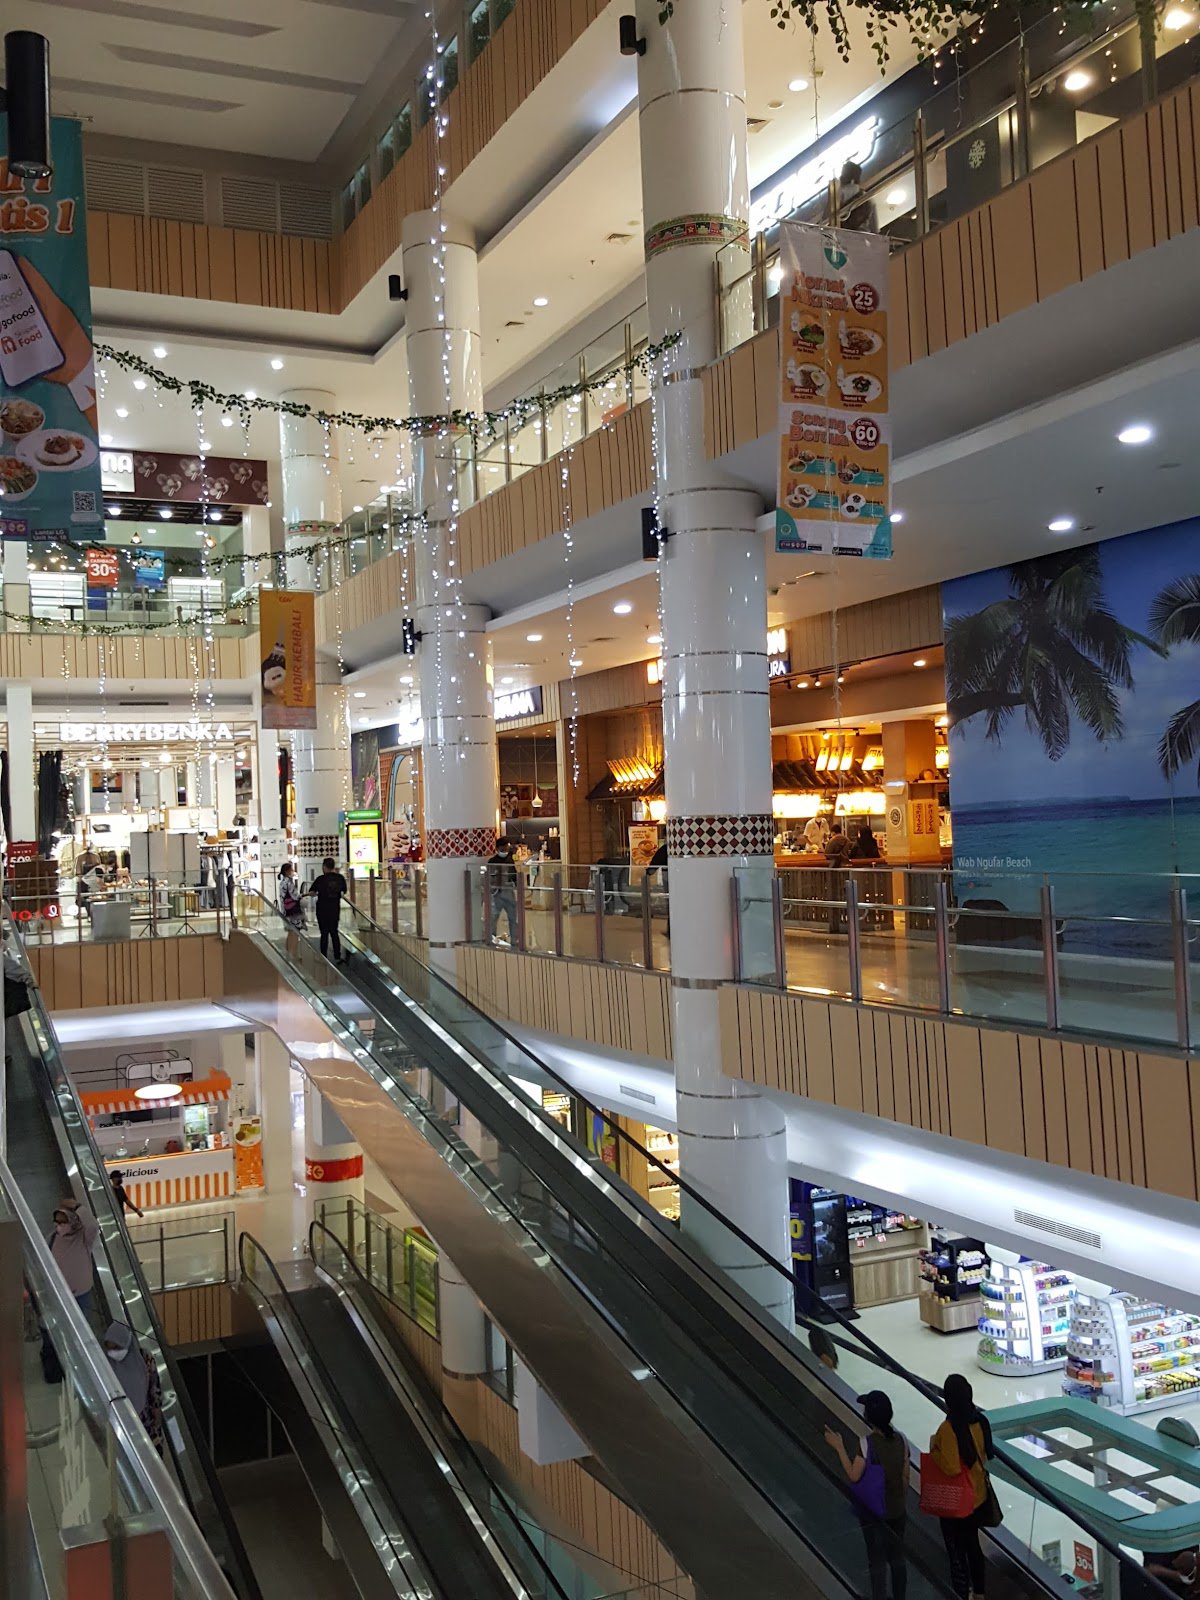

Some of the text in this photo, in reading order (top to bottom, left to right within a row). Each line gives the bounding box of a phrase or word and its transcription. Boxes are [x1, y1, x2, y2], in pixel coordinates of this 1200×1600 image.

[55, 199, 75, 234] 1
[854, 291, 873, 306] 25
[2, 305, 35, 329] gofood
[18, 330, 43, 347] Food
[855, 426, 878, 441] 60
[291, 609, 303, 702] HADIR KEMBALI
[60, 723, 233, 741] BERRYBENKA
[957, 856, 1032, 870] Wab Ngufar Beach
[120, 1168, 159, 1178] elicious
[1076, 1556, 1093, 1571] 30%
